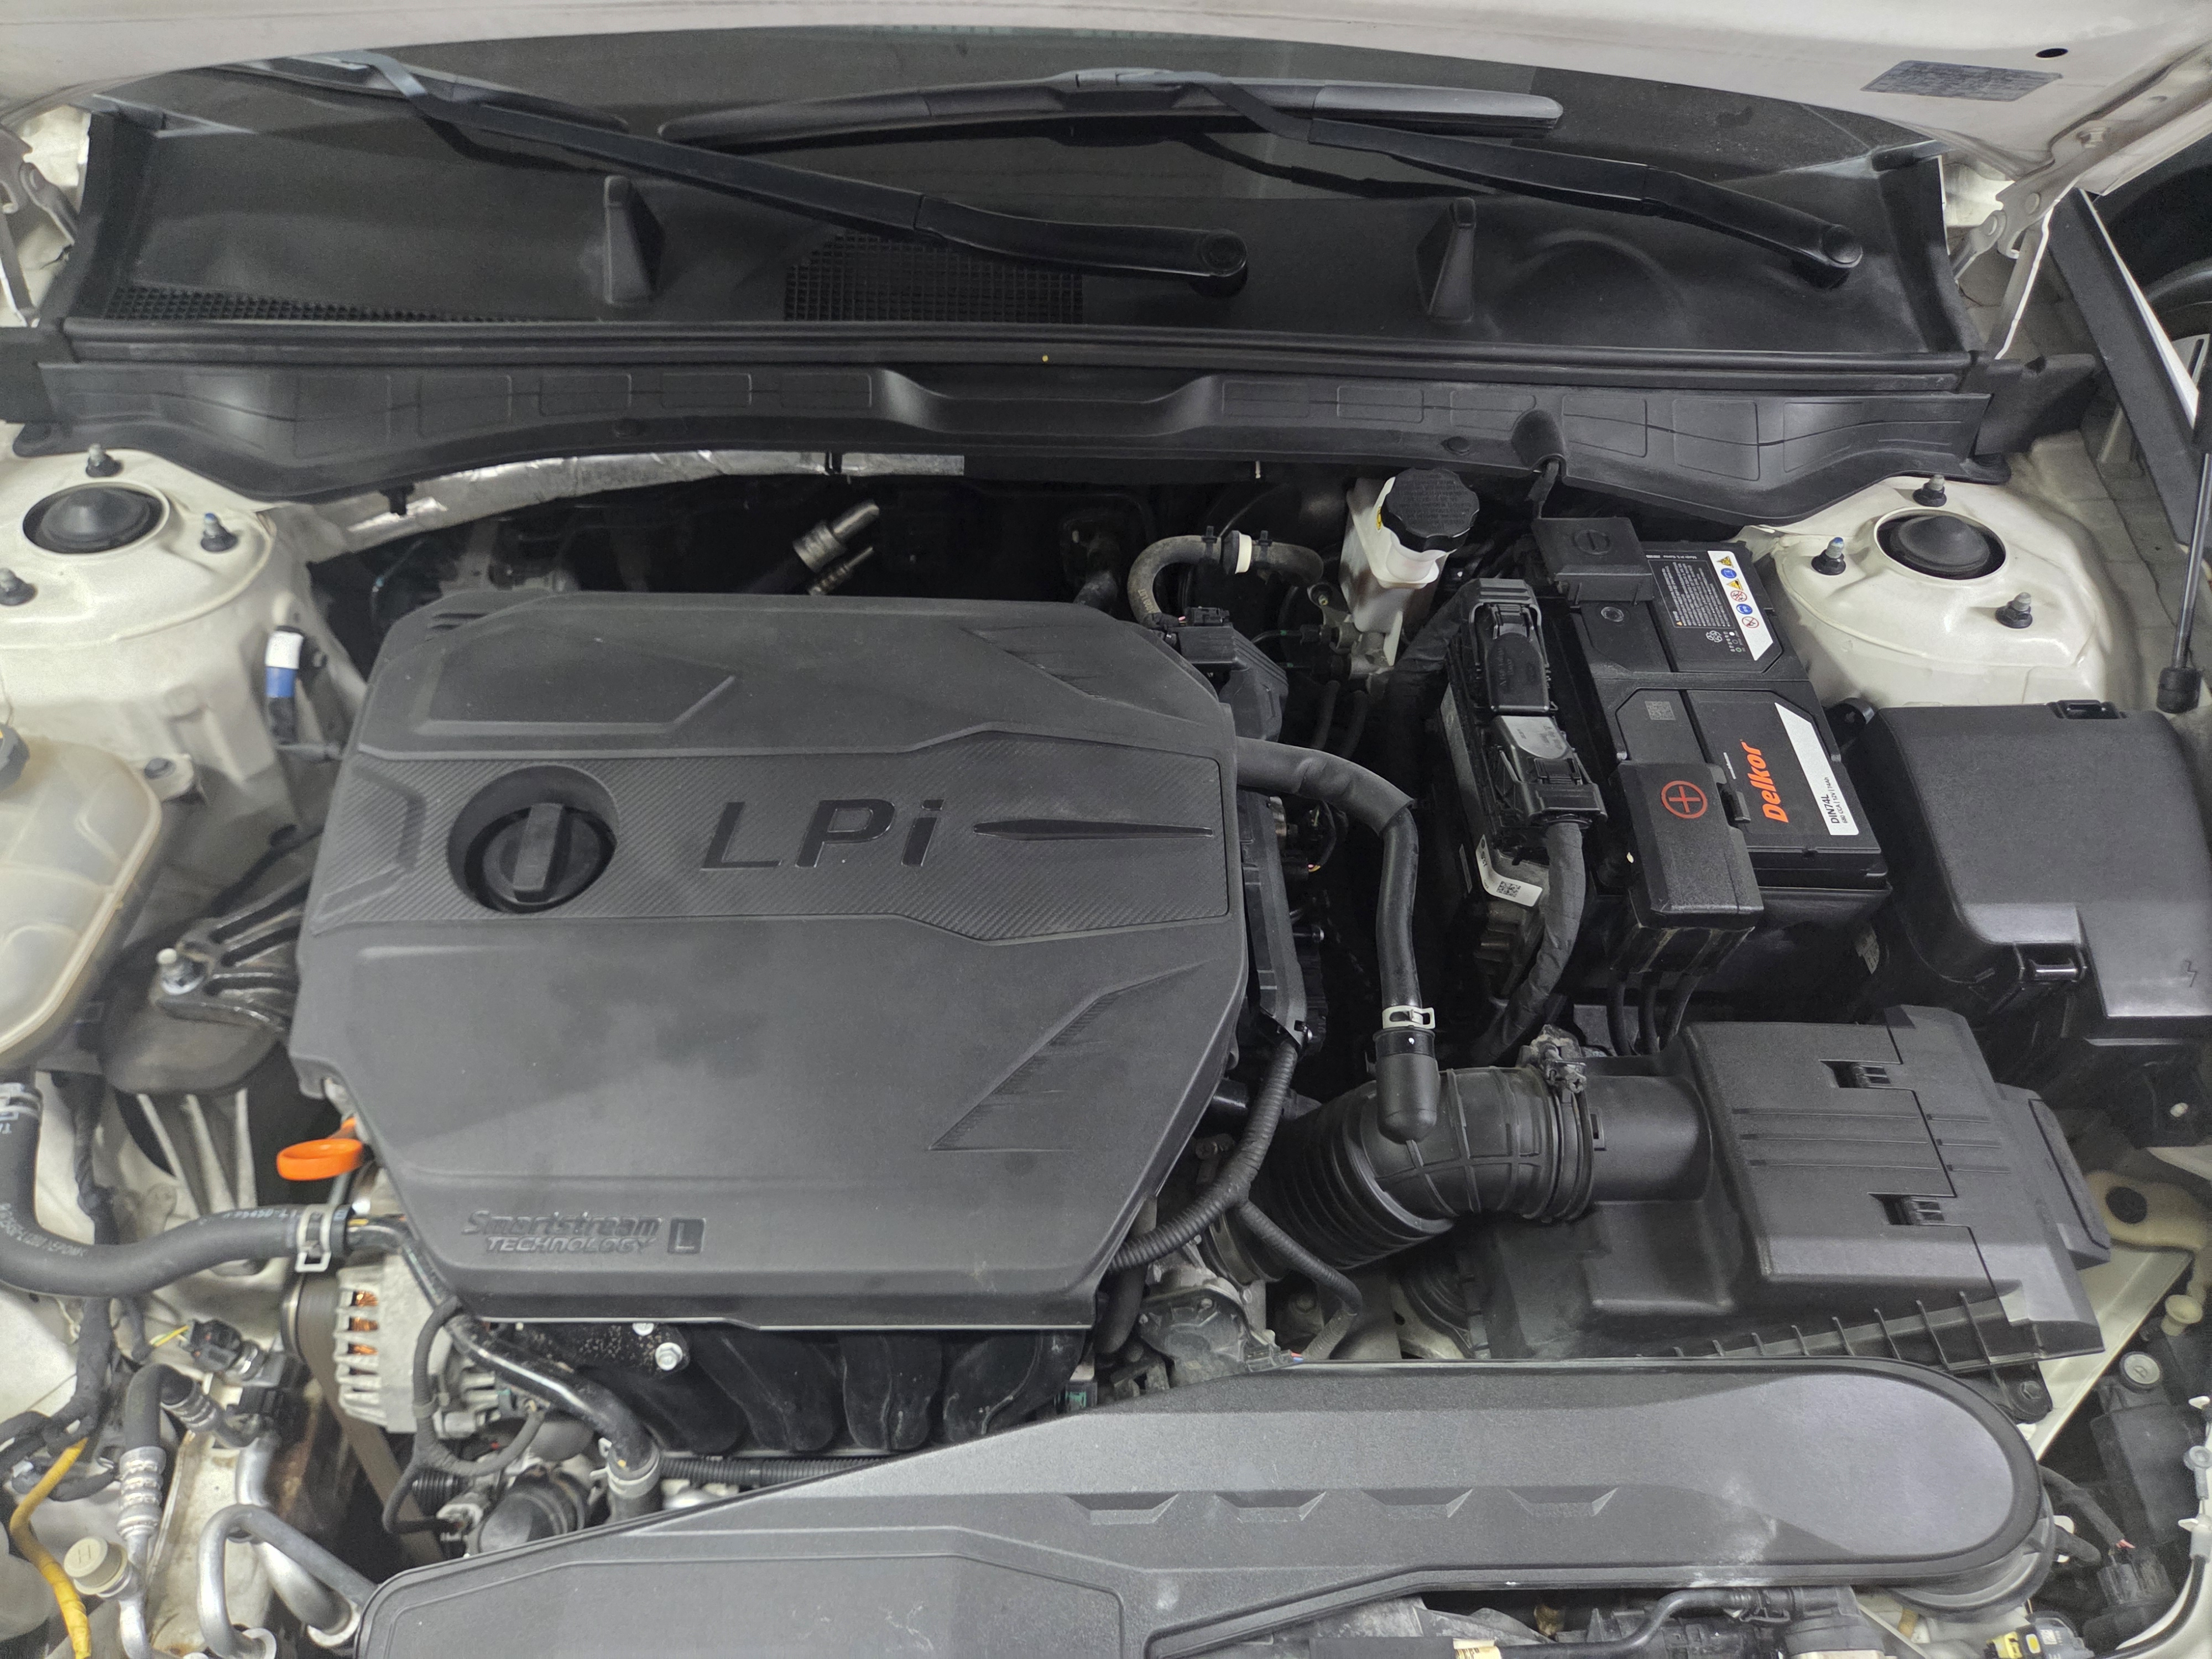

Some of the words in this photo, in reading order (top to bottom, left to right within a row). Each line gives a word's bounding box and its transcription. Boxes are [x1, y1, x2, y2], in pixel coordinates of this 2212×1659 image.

[1741, 742, 1789, 823] Delkor
[1821, 794, 1840, 823] DIN74L
[1840, 815, 1848, 823] 680
[700, 799, 945, 871] LPi
[461, 1210, 661, 1235] Smartstream
[673, 1220, 698, 1251] L
